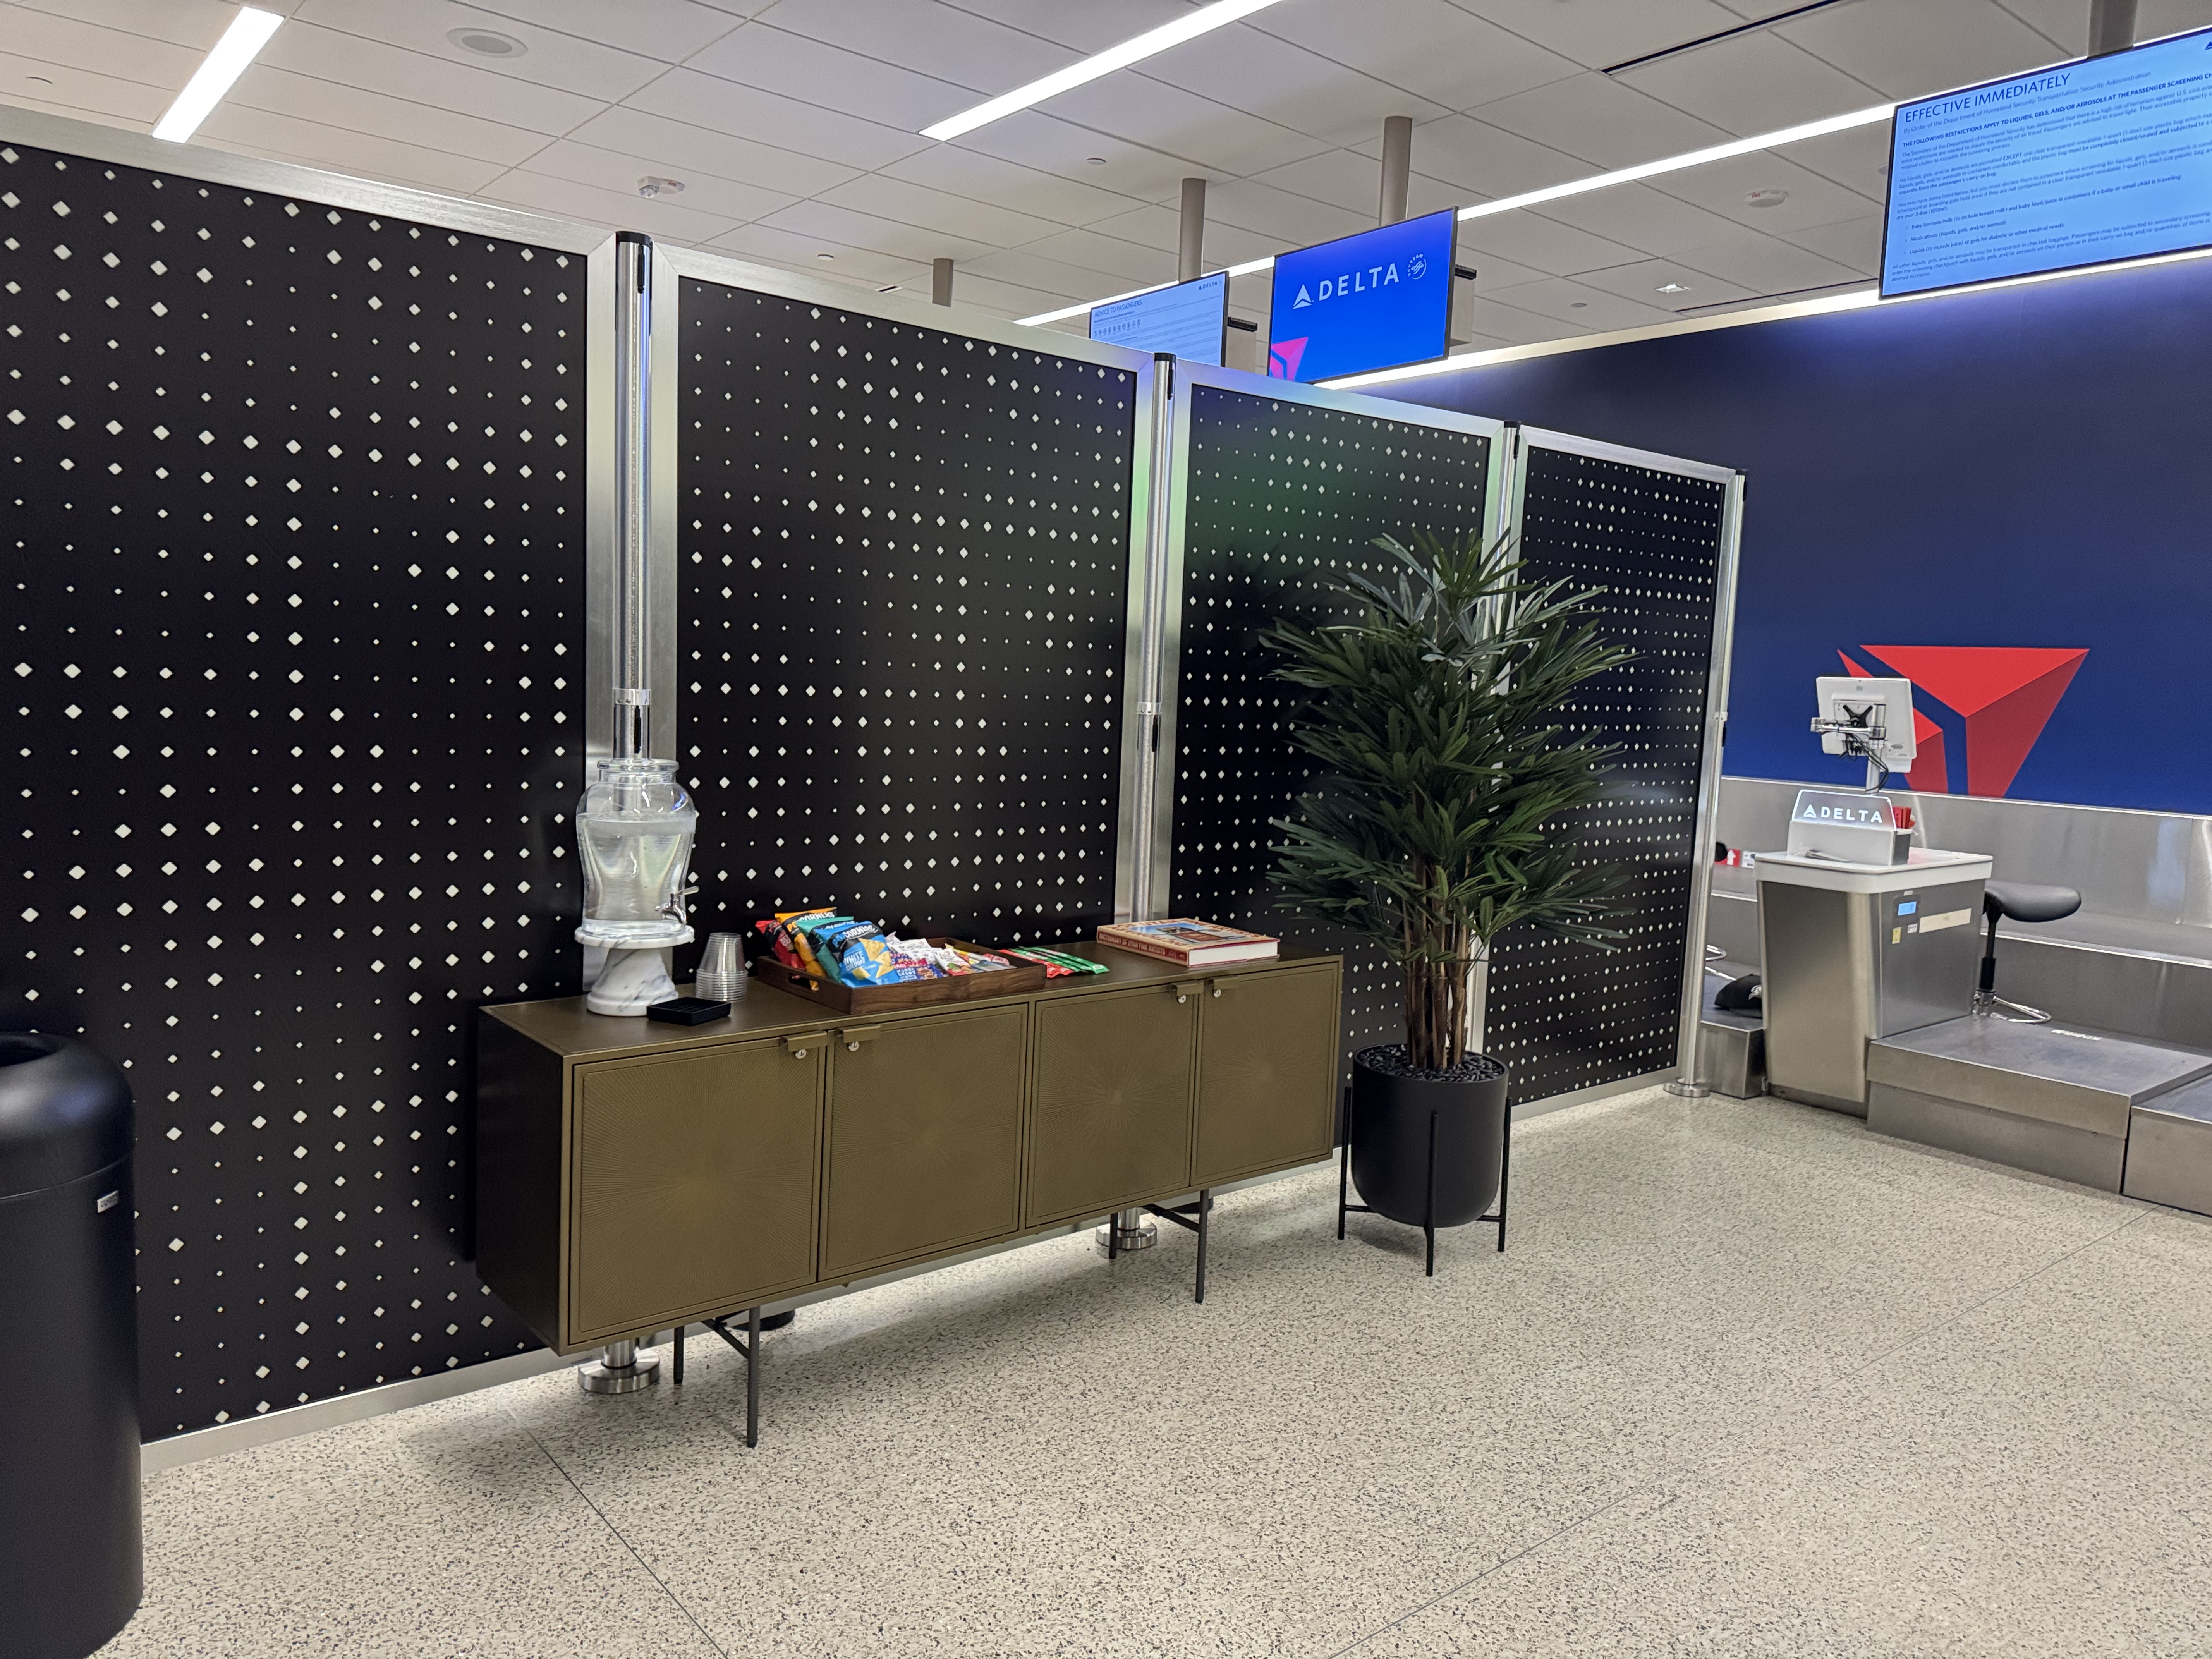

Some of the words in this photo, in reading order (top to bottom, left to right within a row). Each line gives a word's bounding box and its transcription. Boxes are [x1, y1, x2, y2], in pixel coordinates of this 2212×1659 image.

[1905, 98, 1970, 122] EFFECTIVE
[1975, 73, 2070, 106] IMMEDIATELY
[1913, 134, 1944, 145] FOLLOWING
[1945, 125, 1982, 137] RESTRICTIONS
[2010, 113, 2033, 123] LIQUIDS,
[2035, 109, 2049, 117] GELS,
[2051, 103, 2075, 114] AND/OR
[2076, 96, 2106, 108] AEROSOLS
[2131, 82, 2166, 95] PASSENGER
[2167, 74, 2202, 87] SCREENING
[1203, 281, 1217, 289] DELTA
[1319, 263, 1399, 301] DELTA
[1116, 299, 1142, 311] PASSENGERS
[1821, 806, 1883, 823] DELTA
[1099, 933, 1122, 944] DICTIONARY
[1127, 940, 1138, 948] UTAH
[1139, 943, 1148, 951] FINE
[1148, 945, 1166, 955] ARTISTS
[843, 950, 864, 965] WHITE
